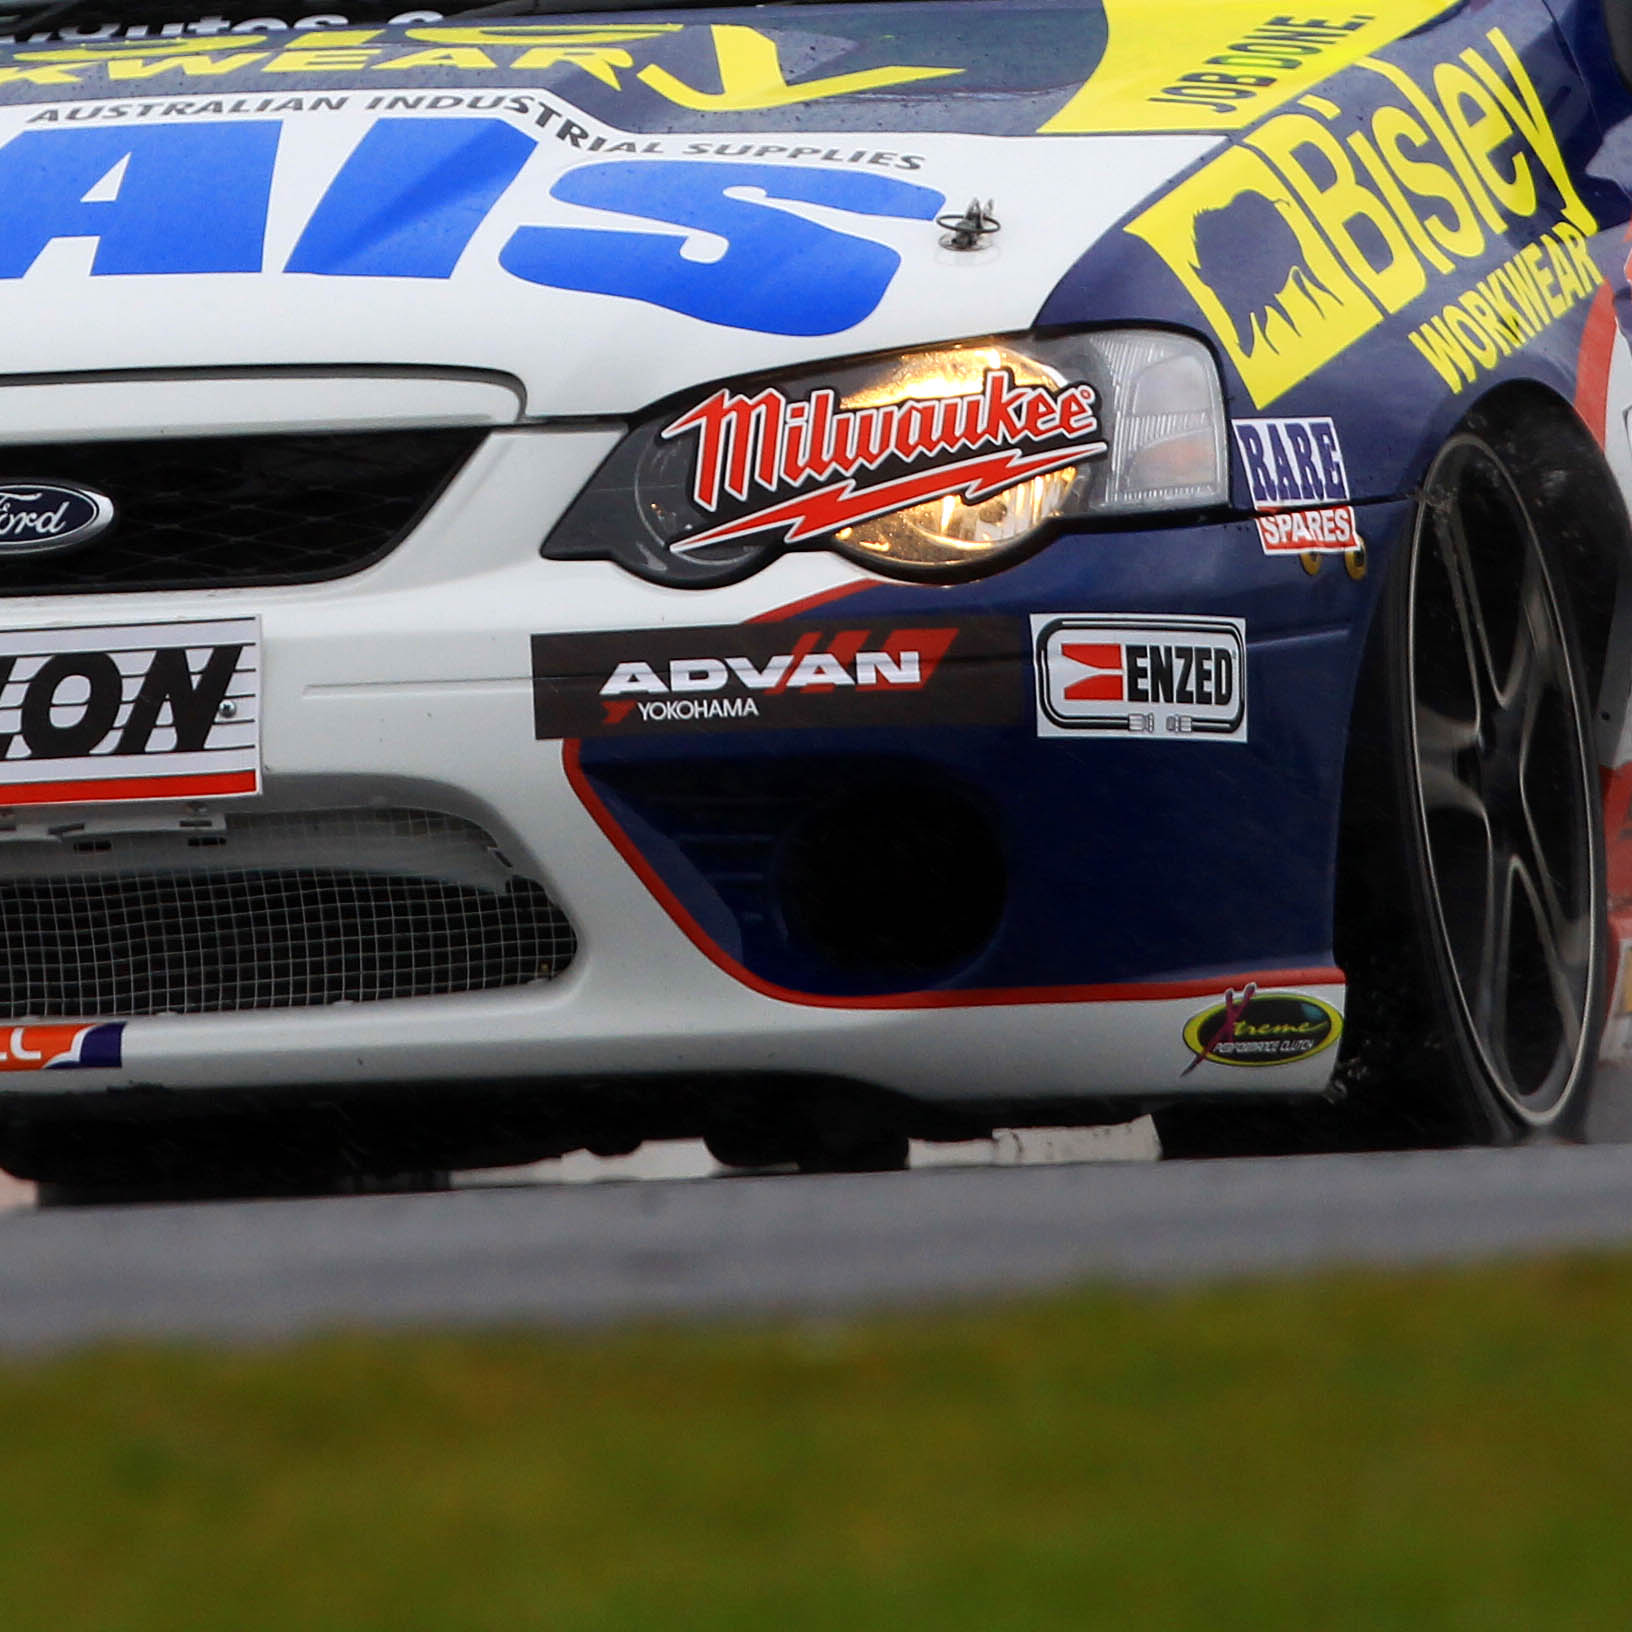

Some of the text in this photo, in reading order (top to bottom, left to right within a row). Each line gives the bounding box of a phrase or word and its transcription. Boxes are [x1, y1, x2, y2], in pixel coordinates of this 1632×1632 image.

[1147, 72, 1277, 113] JOB
[26, 93, 925, 171] AUSTRALIAN INDUSTRIAL SUPPLIES
[1244, 27, 1598, 314] Bisley
[1408, 221, 1602, 395] WORKWEAR
[662, 369, 1096, 511] Milwaukee
[1235, 422, 1348, 501] RARE
[1261, 508, 1351, 545] SPARES
[600, 651, 924, 694] ADVAN
[1124, 643, 1232, 705] ENZED
[637, 696, 759, 721] YOKOHAMA
